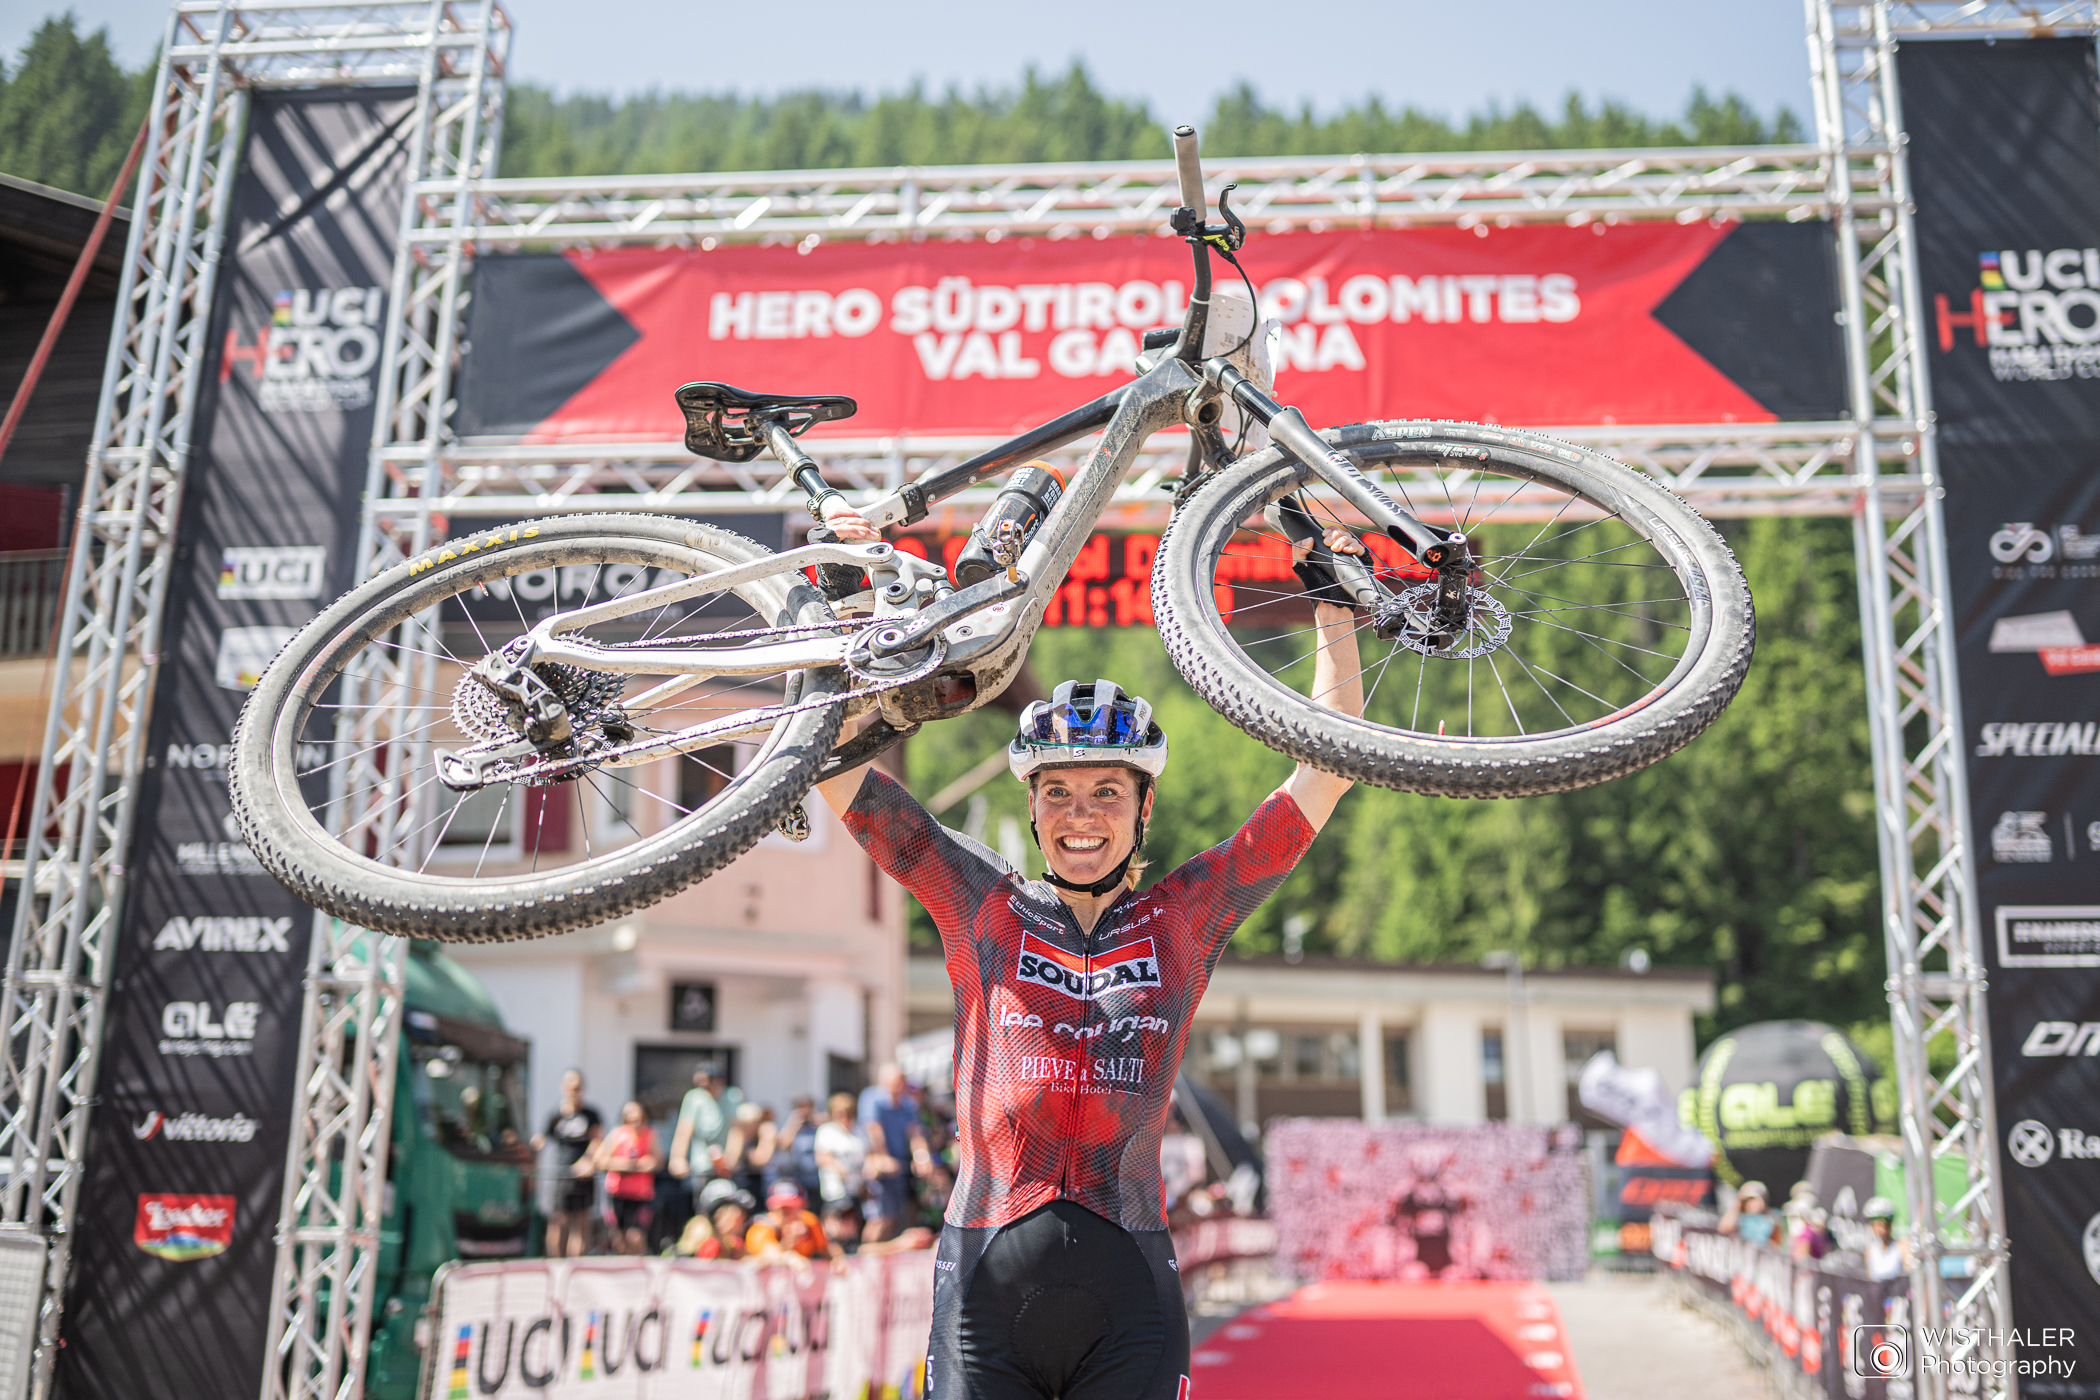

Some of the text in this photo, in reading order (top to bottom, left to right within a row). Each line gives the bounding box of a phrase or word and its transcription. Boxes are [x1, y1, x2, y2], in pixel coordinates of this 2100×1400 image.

[2000, 248, 2100, 291] UCI
[293, 286, 382, 327] UCI
[709, 273, 1581, 340] HERO SÜDTIROL OLOMITES
[1934, 286, 2100, 354] HERO
[218, 323, 380, 385] HERO
[912, 324, 1366, 380] VAL GANA
[1371, 426, 1433, 441] ASPEN
[1219, 484, 1266, 525] URSUS
[1366, 483, 1402, 516] SWISS
[409, 526, 541, 577] MAXXIS
[434, 552, 512, 584] URSUS
[241, 561, 311, 586] UCI
[296, 627, 357, 691] MAIRHOFER
[1975, 721, 2100, 757] SPECIAL
[1008, 894, 1065, 935] EthicSport
[1098, 914, 1151, 941] URSUS
[1018, 954, 1159, 996] SOUDAL
[1020, 1056, 1077, 1081] PIEVE
[1092, 1057, 1146, 1084] SALTI
[1050, 1082, 1112, 1096] Bike Hotel
[163, 1111, 258, 1142] vittoria
[477, 1315, 569, 1396] UCI
[603, 1309, 670, 1376] UCI
